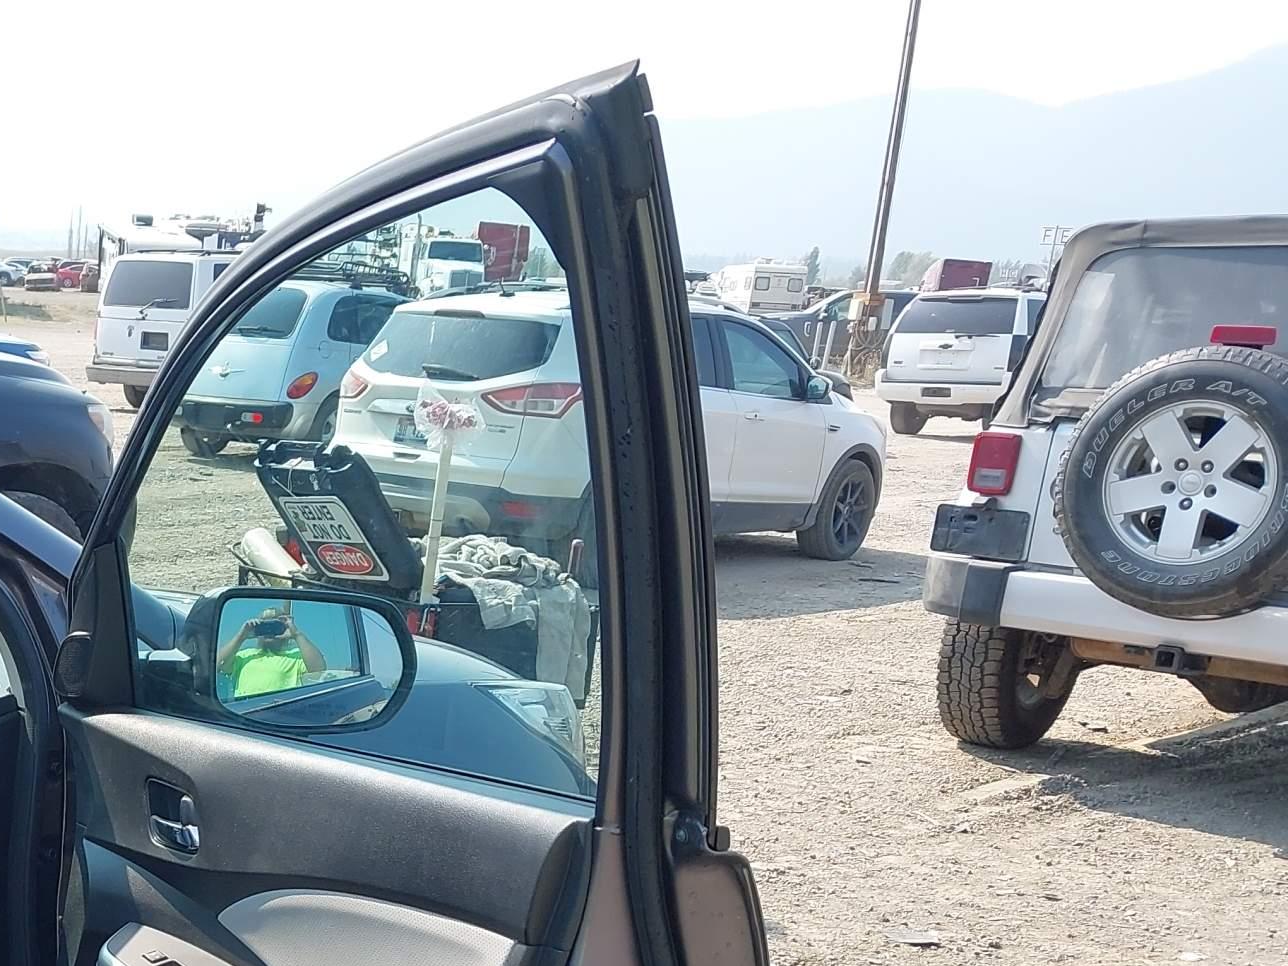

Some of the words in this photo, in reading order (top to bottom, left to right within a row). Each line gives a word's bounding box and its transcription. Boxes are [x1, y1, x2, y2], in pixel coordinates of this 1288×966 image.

[1083, 379, 1195, 478] DUELER
[1206, 380, 1267, 406] A/T
[297, 504, 336, 521] ENTER
[307, 523, 333, 541] NOT
[330, 523, 352, 541] DO
[321, 550, 369, 568] DANGER
